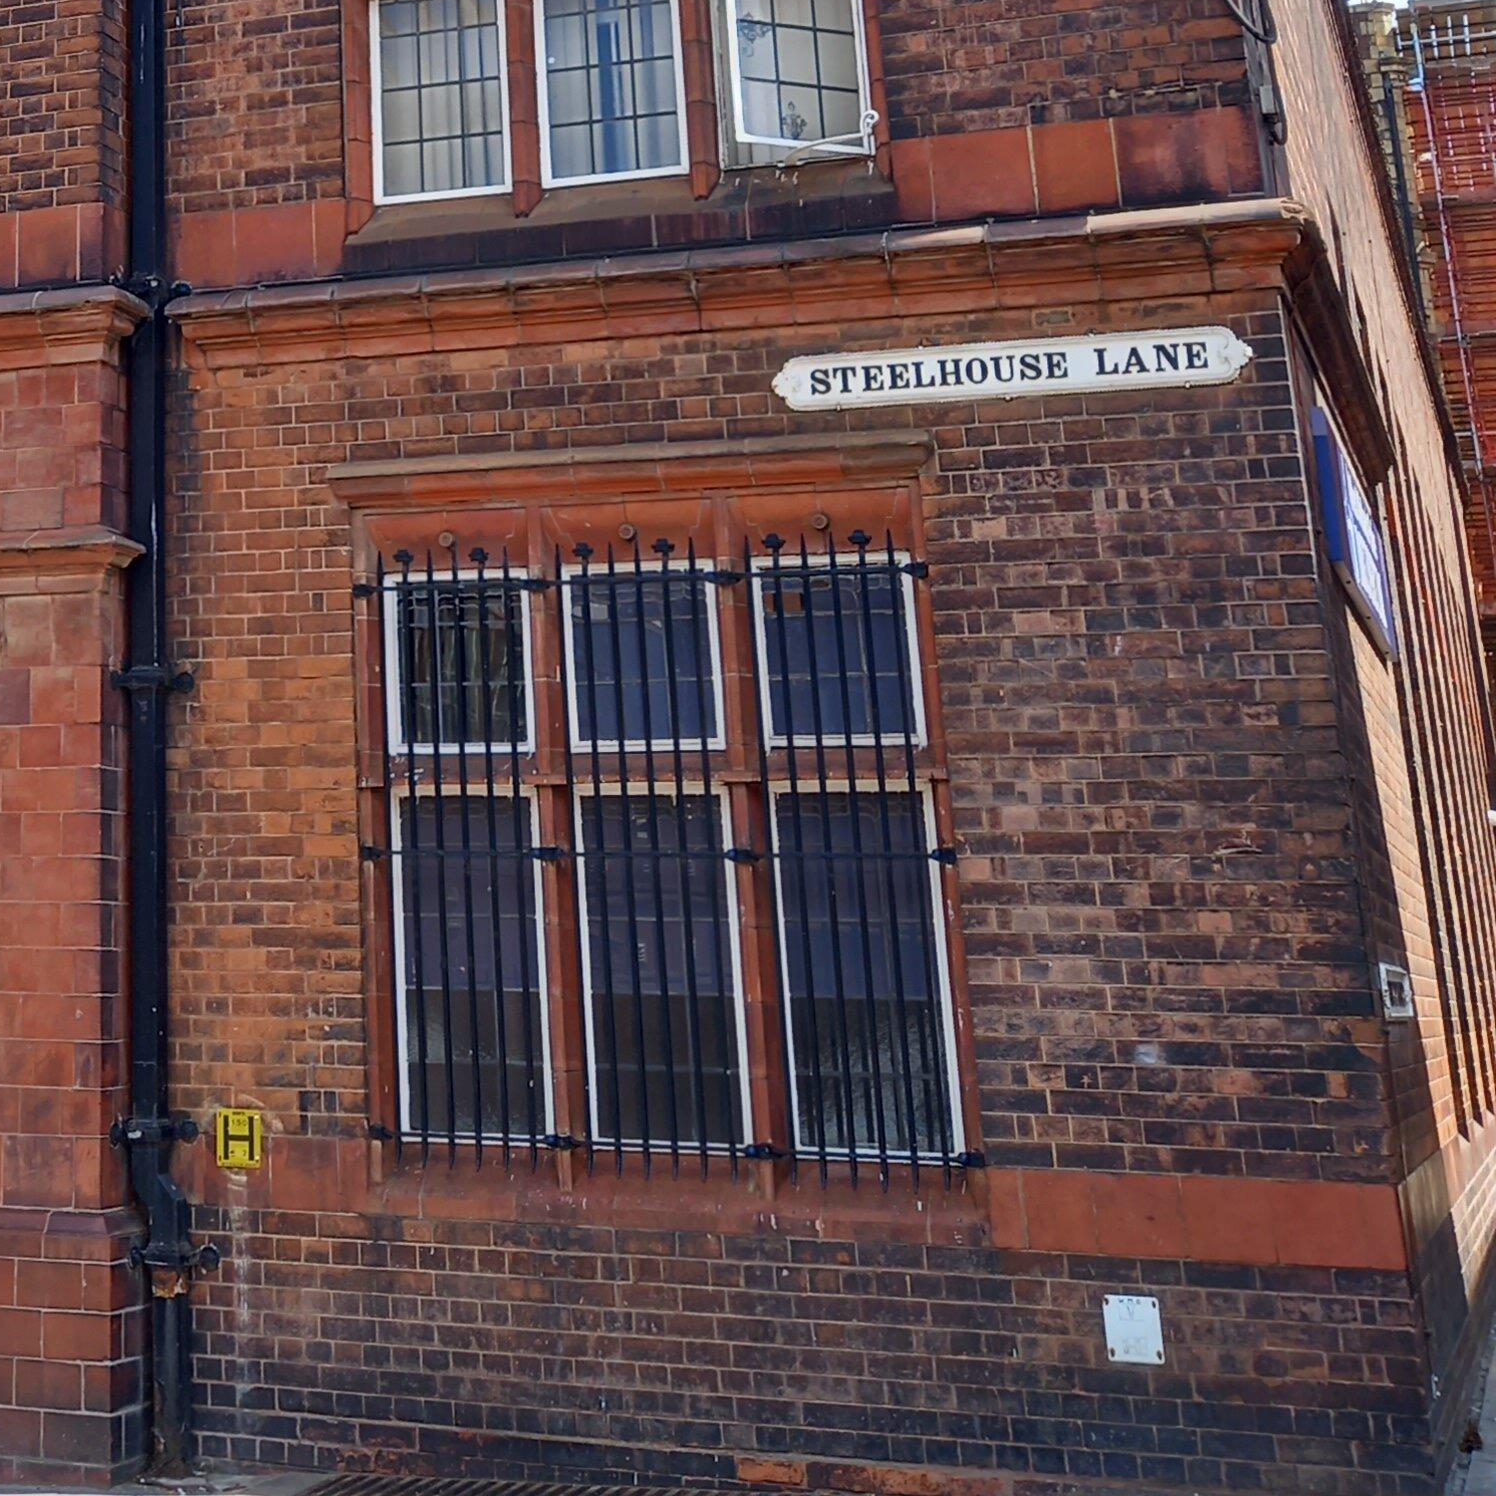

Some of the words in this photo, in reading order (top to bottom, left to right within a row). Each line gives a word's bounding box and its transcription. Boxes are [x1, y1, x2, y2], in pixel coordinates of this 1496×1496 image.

[810, 352, 1069, 395] STEELHOUSE
[1093, 341, 1209, 376] LANE
[223, 1115, 254, 1161] H
